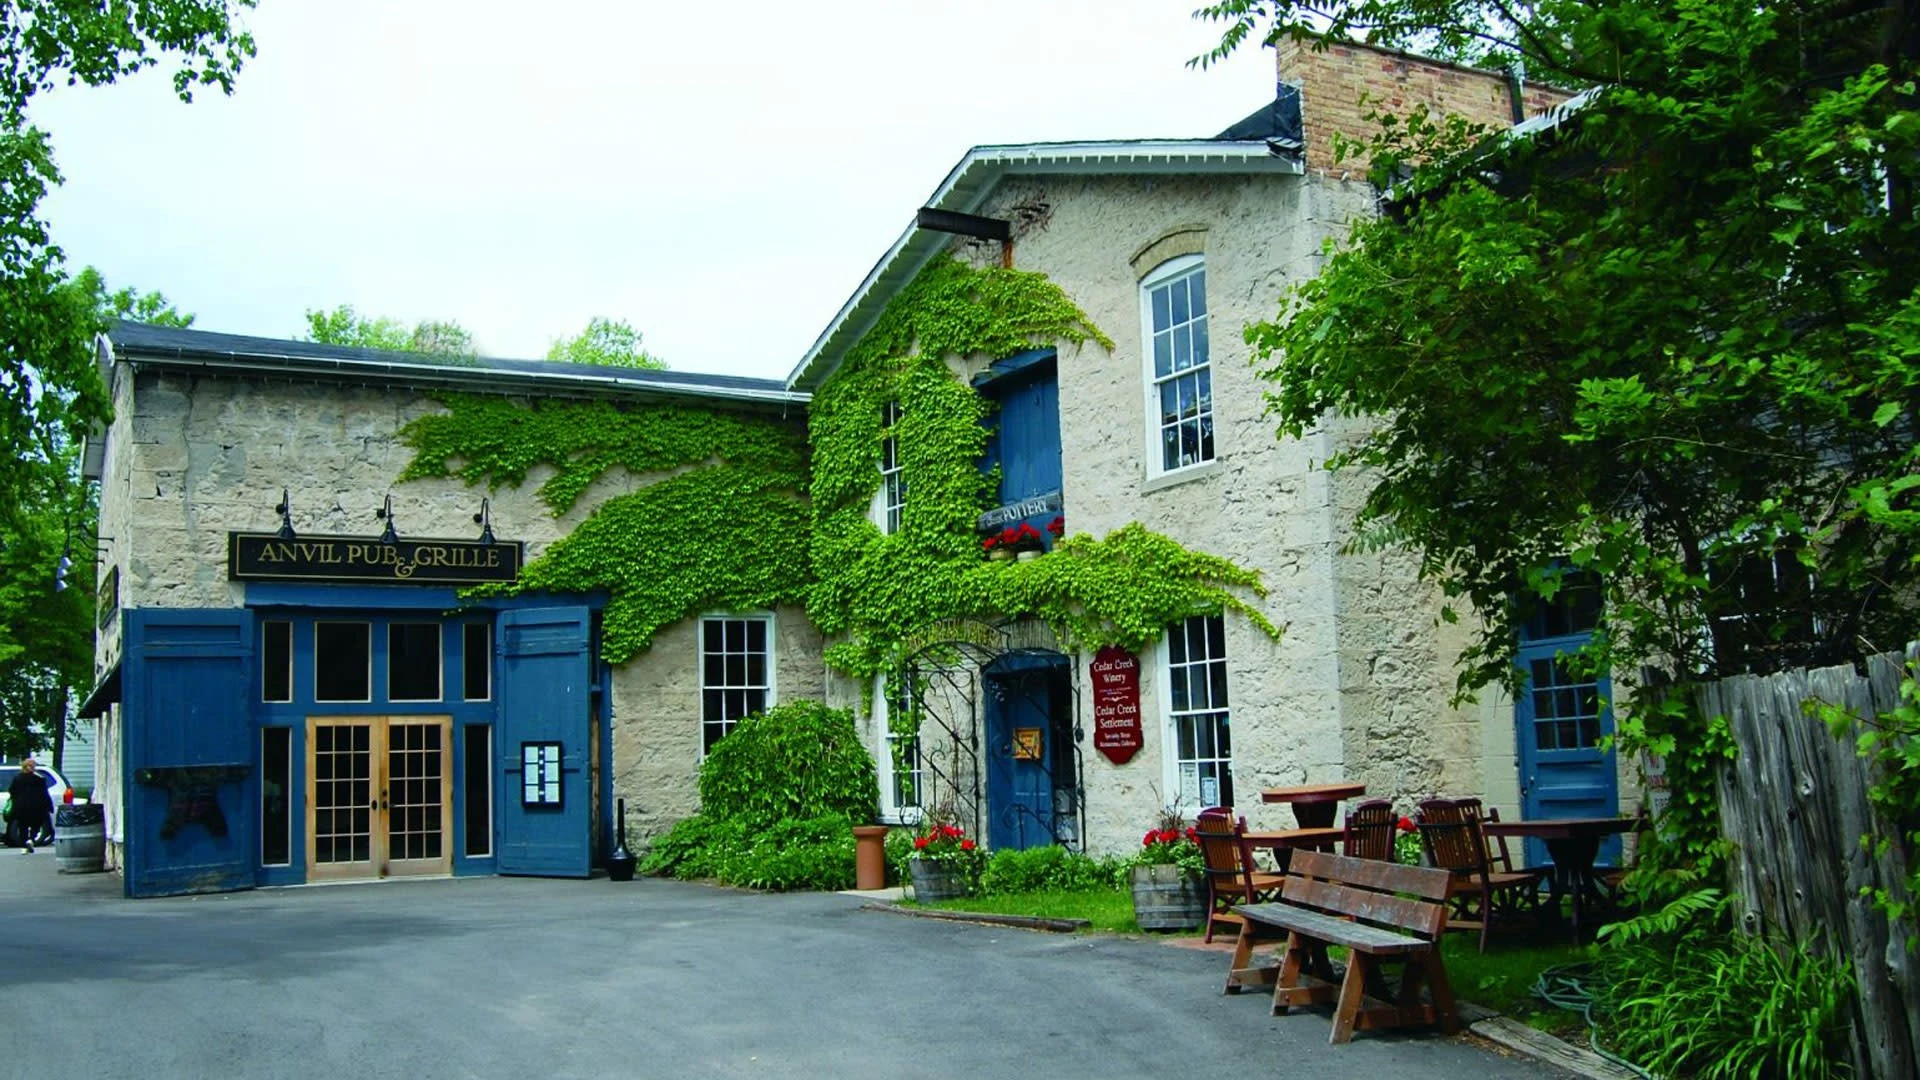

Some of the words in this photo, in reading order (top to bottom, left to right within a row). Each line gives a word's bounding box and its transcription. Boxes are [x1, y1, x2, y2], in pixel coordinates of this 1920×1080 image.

[1003, 499, 1048, 521] POTTERY
[258, 543, 342, 563] ANVIL
[347, 545, 397, 565] PUB
[394, 556, 416, 578] &
[414, 546, 499, 567] GRILLE
[1093, 660, 1113, 672] Cedar
[1114, 658, 1134, 670] Creek
[1102, 673, 1126, 684] Winery
[1096, 705, 1115, 716] Cedar
[1117, 702, 1137, 715] Creek
[1100, 717, 1134, 729] Settlement
